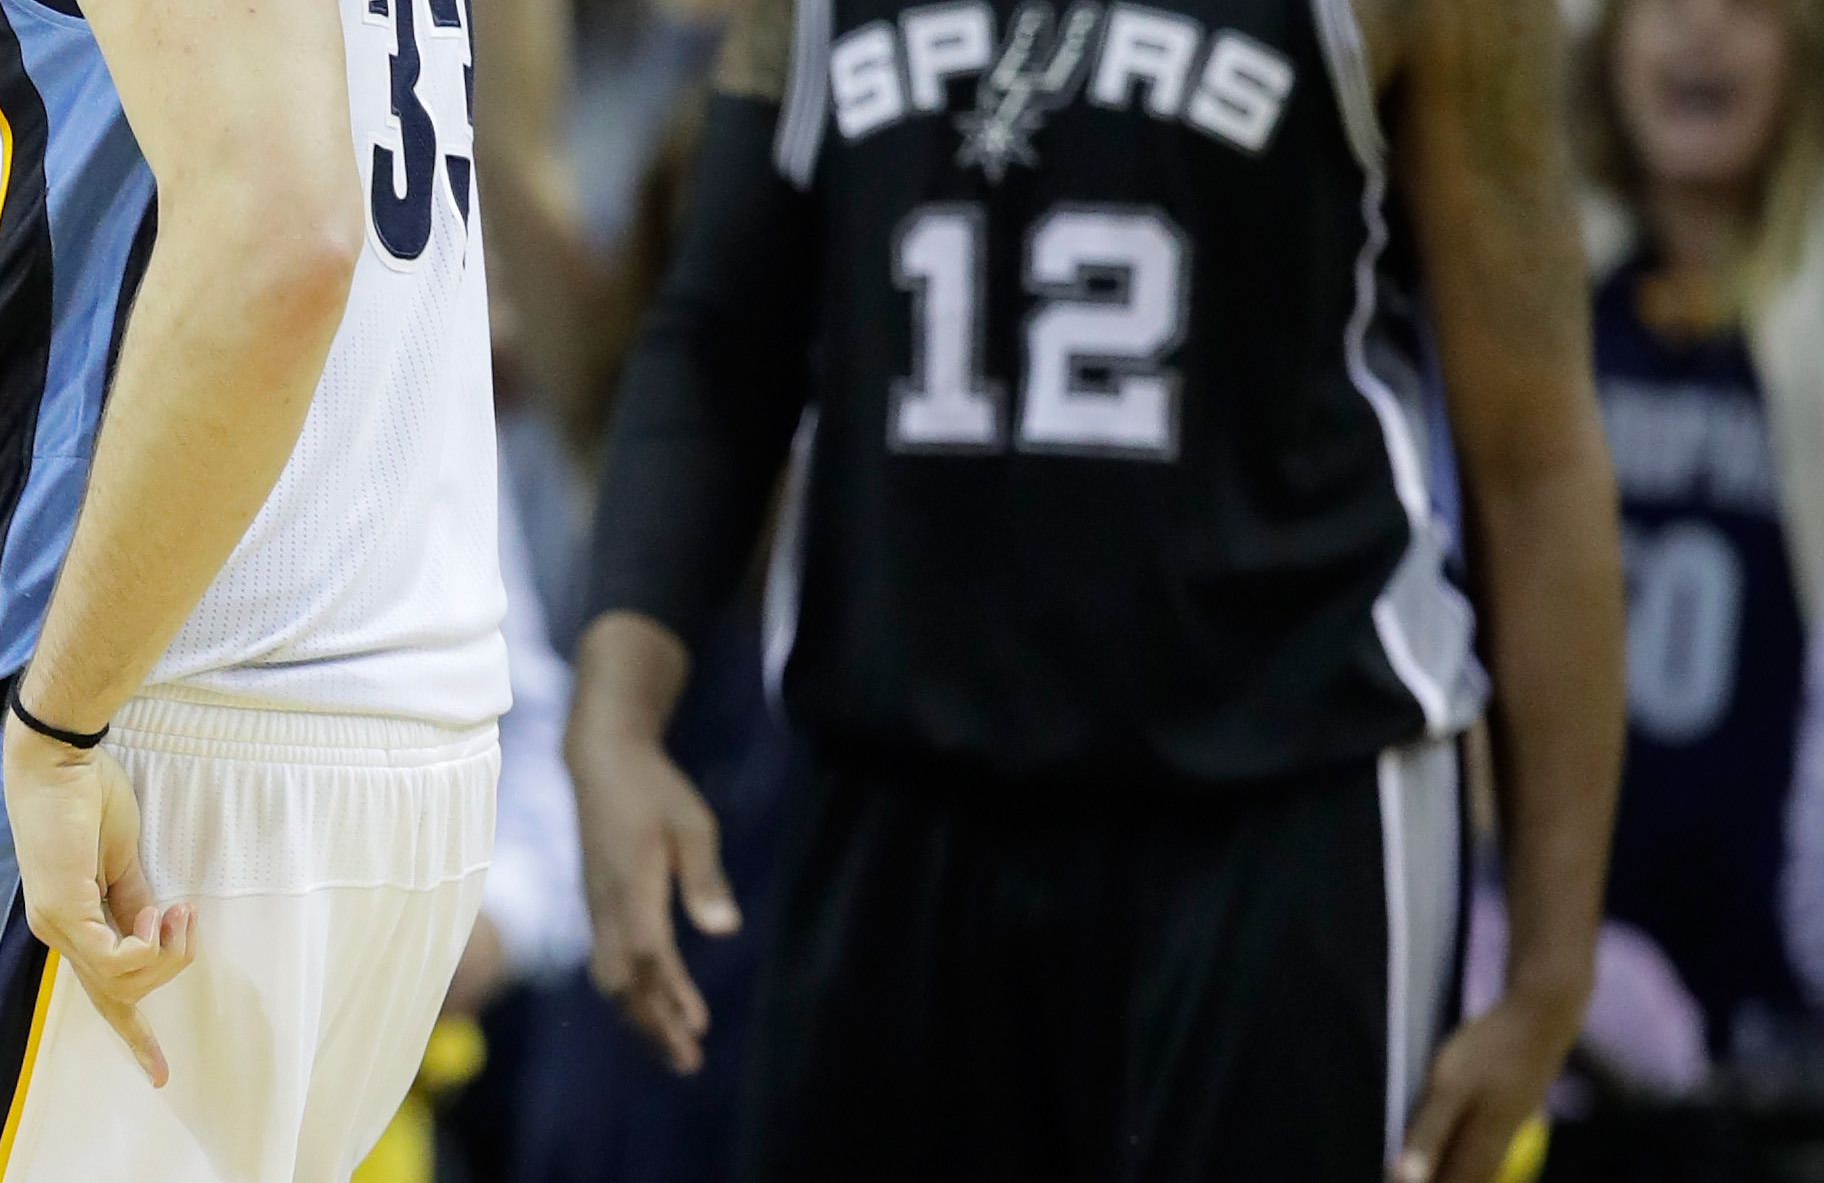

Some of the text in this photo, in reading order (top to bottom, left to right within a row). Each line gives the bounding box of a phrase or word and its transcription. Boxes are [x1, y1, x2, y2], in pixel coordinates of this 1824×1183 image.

[829, 0, 1294, 162] SPURS
[890, 205, 1188, 457] 12
[1622, 519, 1746, 743] 0
